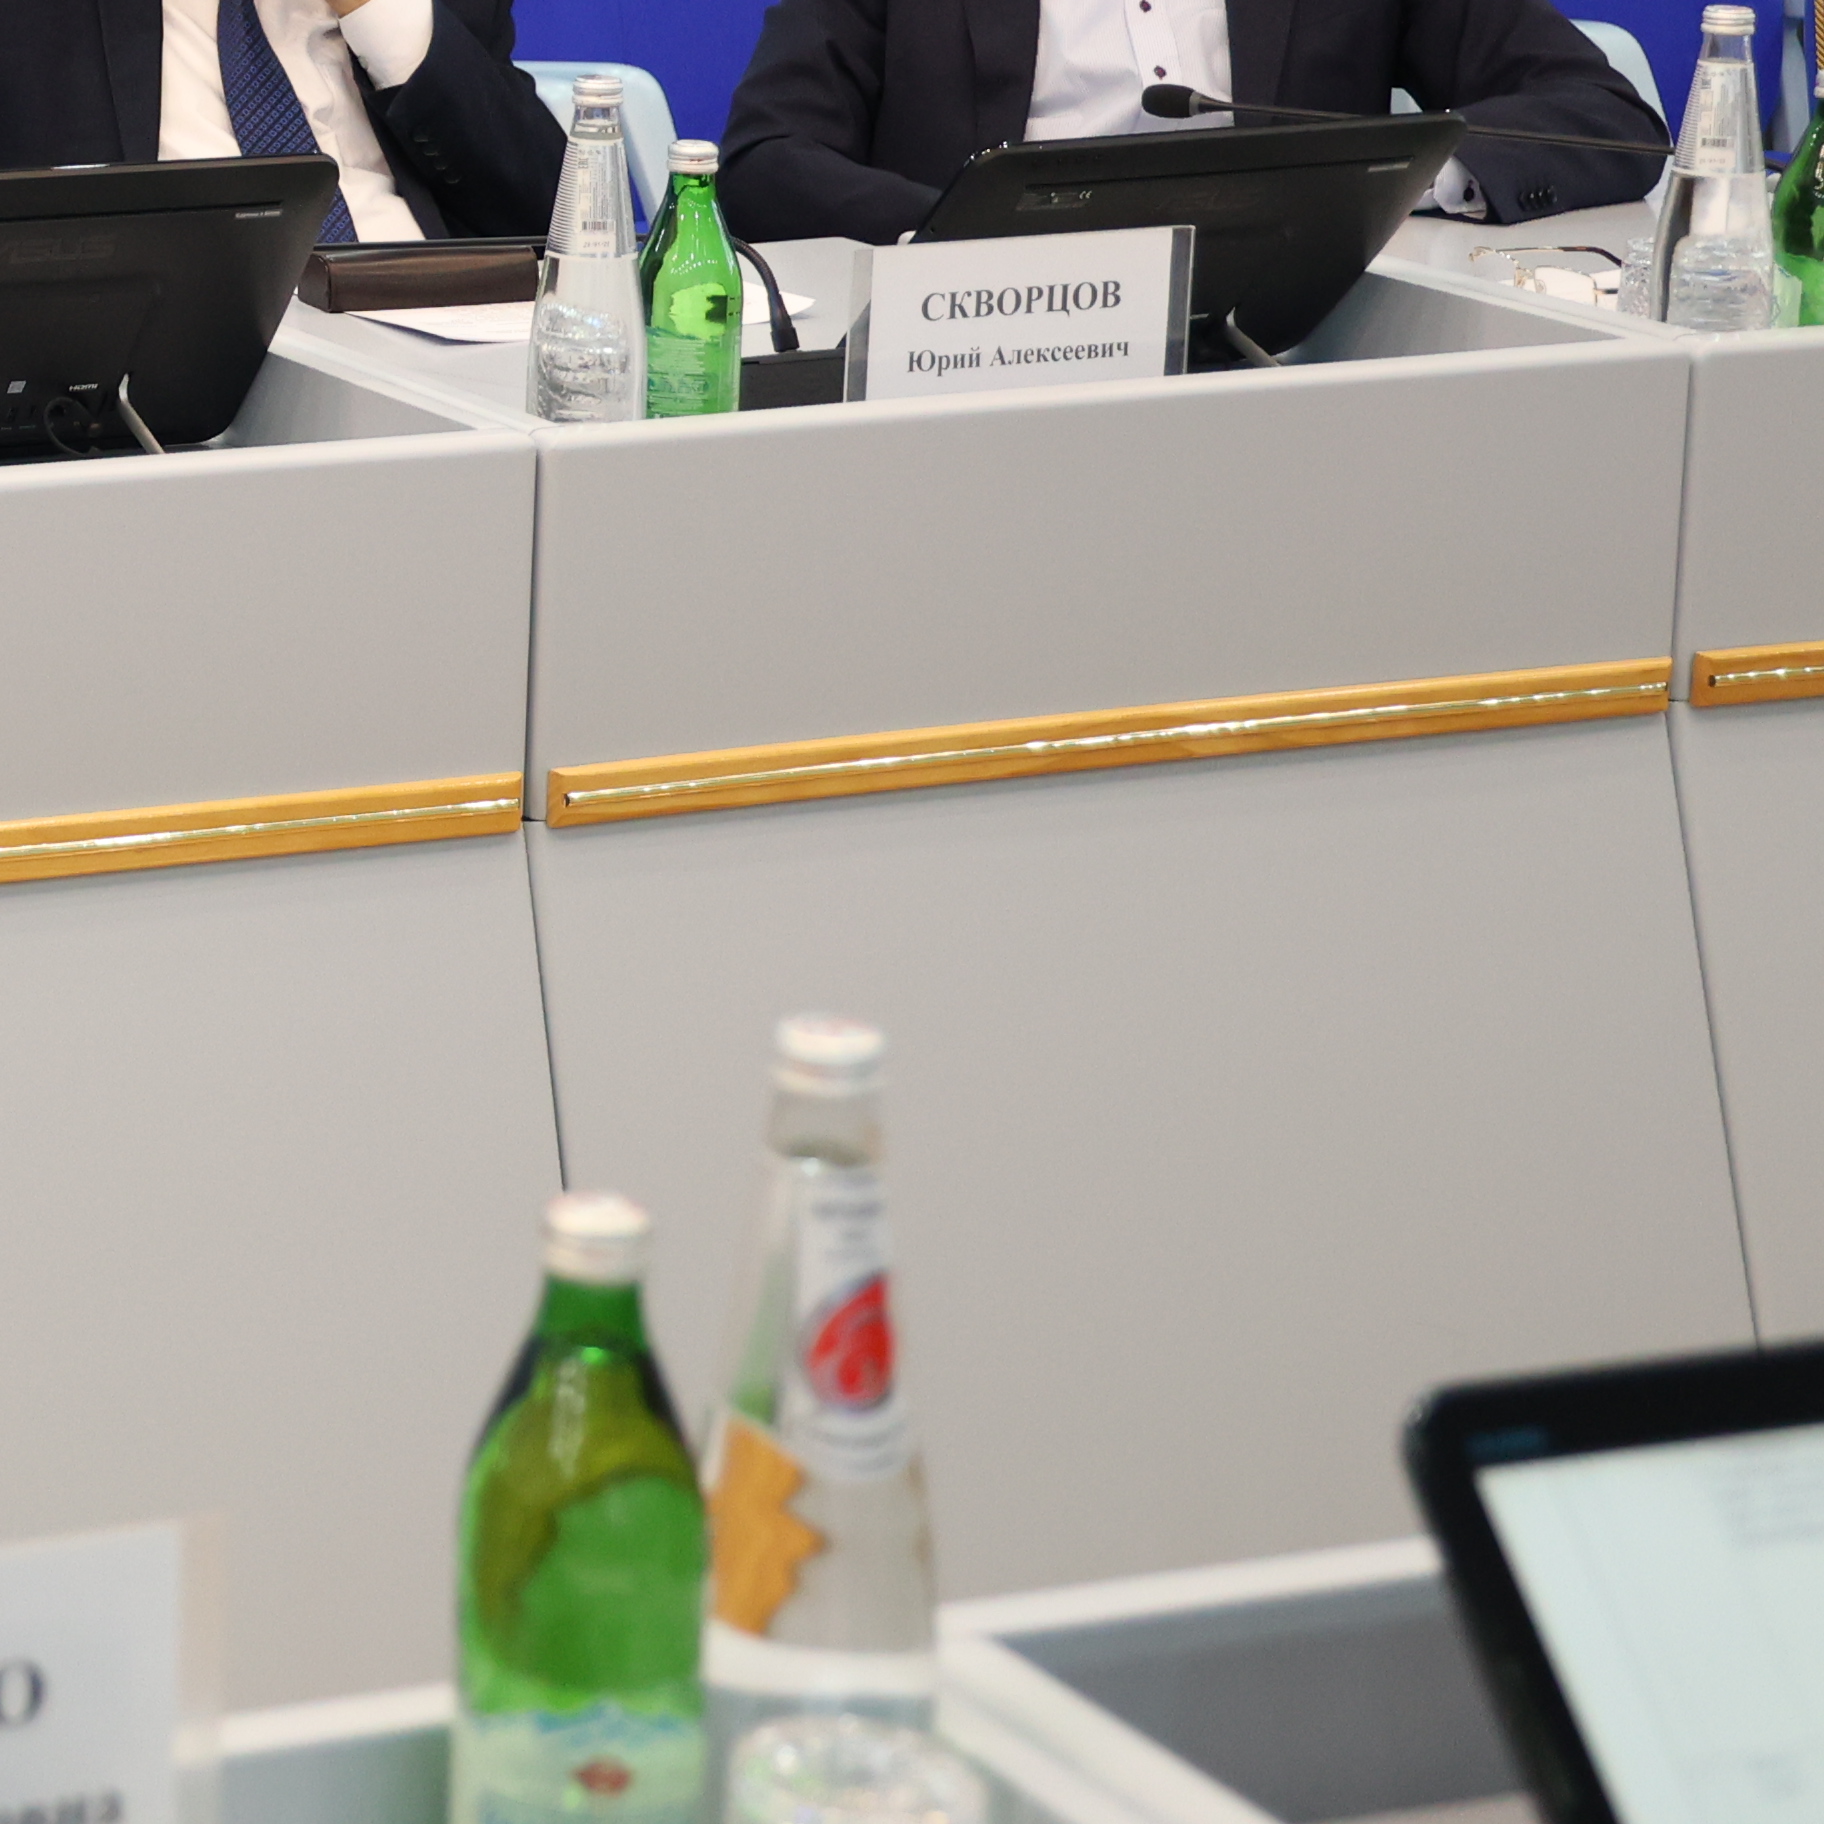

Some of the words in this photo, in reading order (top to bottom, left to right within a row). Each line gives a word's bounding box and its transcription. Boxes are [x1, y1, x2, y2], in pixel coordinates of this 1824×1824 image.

[920, 278, 1122, 322] СКВОРЦОВ
[907, 345, 982, 378] Юрий
[989, 338, 1130, 368] Алексеевич
